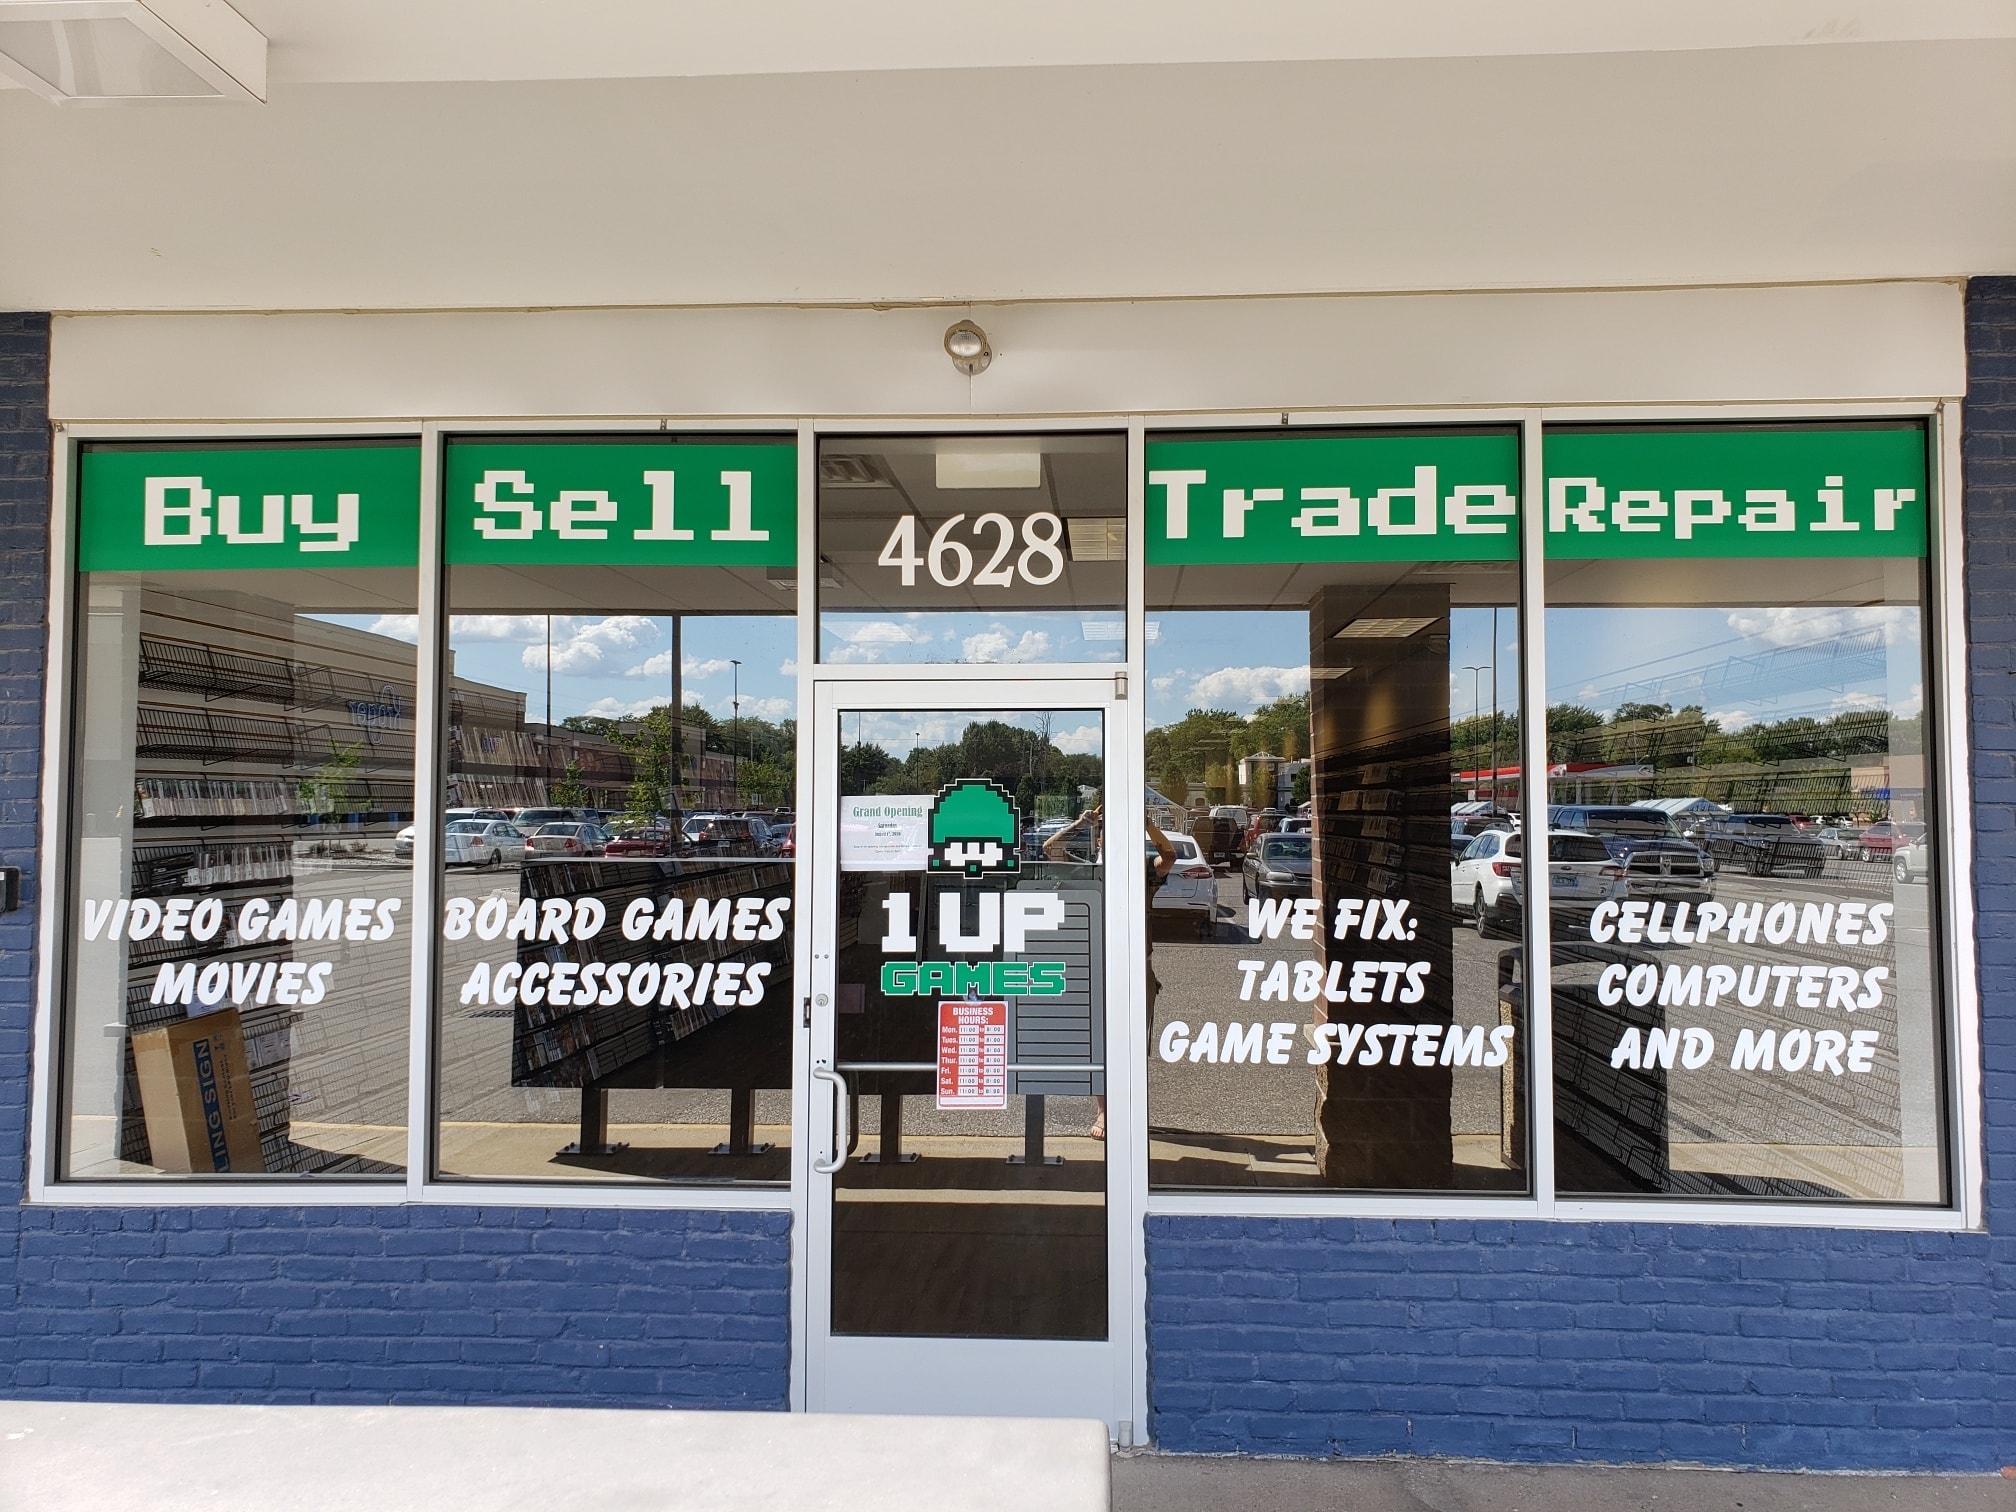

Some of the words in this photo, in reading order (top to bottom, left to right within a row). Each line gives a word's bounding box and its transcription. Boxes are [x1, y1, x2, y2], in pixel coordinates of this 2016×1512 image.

[145, 476, 359, 552] Buy
[474, 470, 769, 541] Sell
[1148, 465, 1516, 539] Trade
[1548, 475, 1915, 539] Repair
[878, 512, 1064, 588] 4628
[853, 806, 881, 817] Grand
[884, 806, 923, 818] Opening
[84, 898, 223, 942] VIDEO
[238, 897, 402, 941] GAMES
[443, 897, 606, 944] BOARD
[622, 897, 791, 941] GAMES
[881, 892, 916, 953] 1
[939, 892, 1065, 953] UP
[1248, 898, 1321, 940] WE
[1333, 898, 1418, 941] FIX:
[1589, 900, 1894, 946] CELLPHONES
[150, 961, 333, 1006] MOVIES
[459, 961, 772, 1010] ACCESSORIES
[881, 961, 1066, 996] GAMES
[1237, 959, 1431, 1004] TABLETS
[1597, 963, 1889, 1013] COMPUTERS
[952, 1007, 994, 1016] BUSINESS
[958, 1016, 989, 1024] HOURS:
[941, 1046, 957, 1054] Wed.
[941, 1056, 958, 1064] Thur.
[942, 1036, 958, 1044] Tues.
[1159, 1020, 1297, 1065] GAME
[1306, 1023, 1515, 1067] SYSTEMS
[1610, 1027, 1715, 1070] AND
[1730, 1028, 1880, 1077] MORE
[196, 1041, 216, 1104] SIGN
[940, 1077, 953, 1085] Sat.
